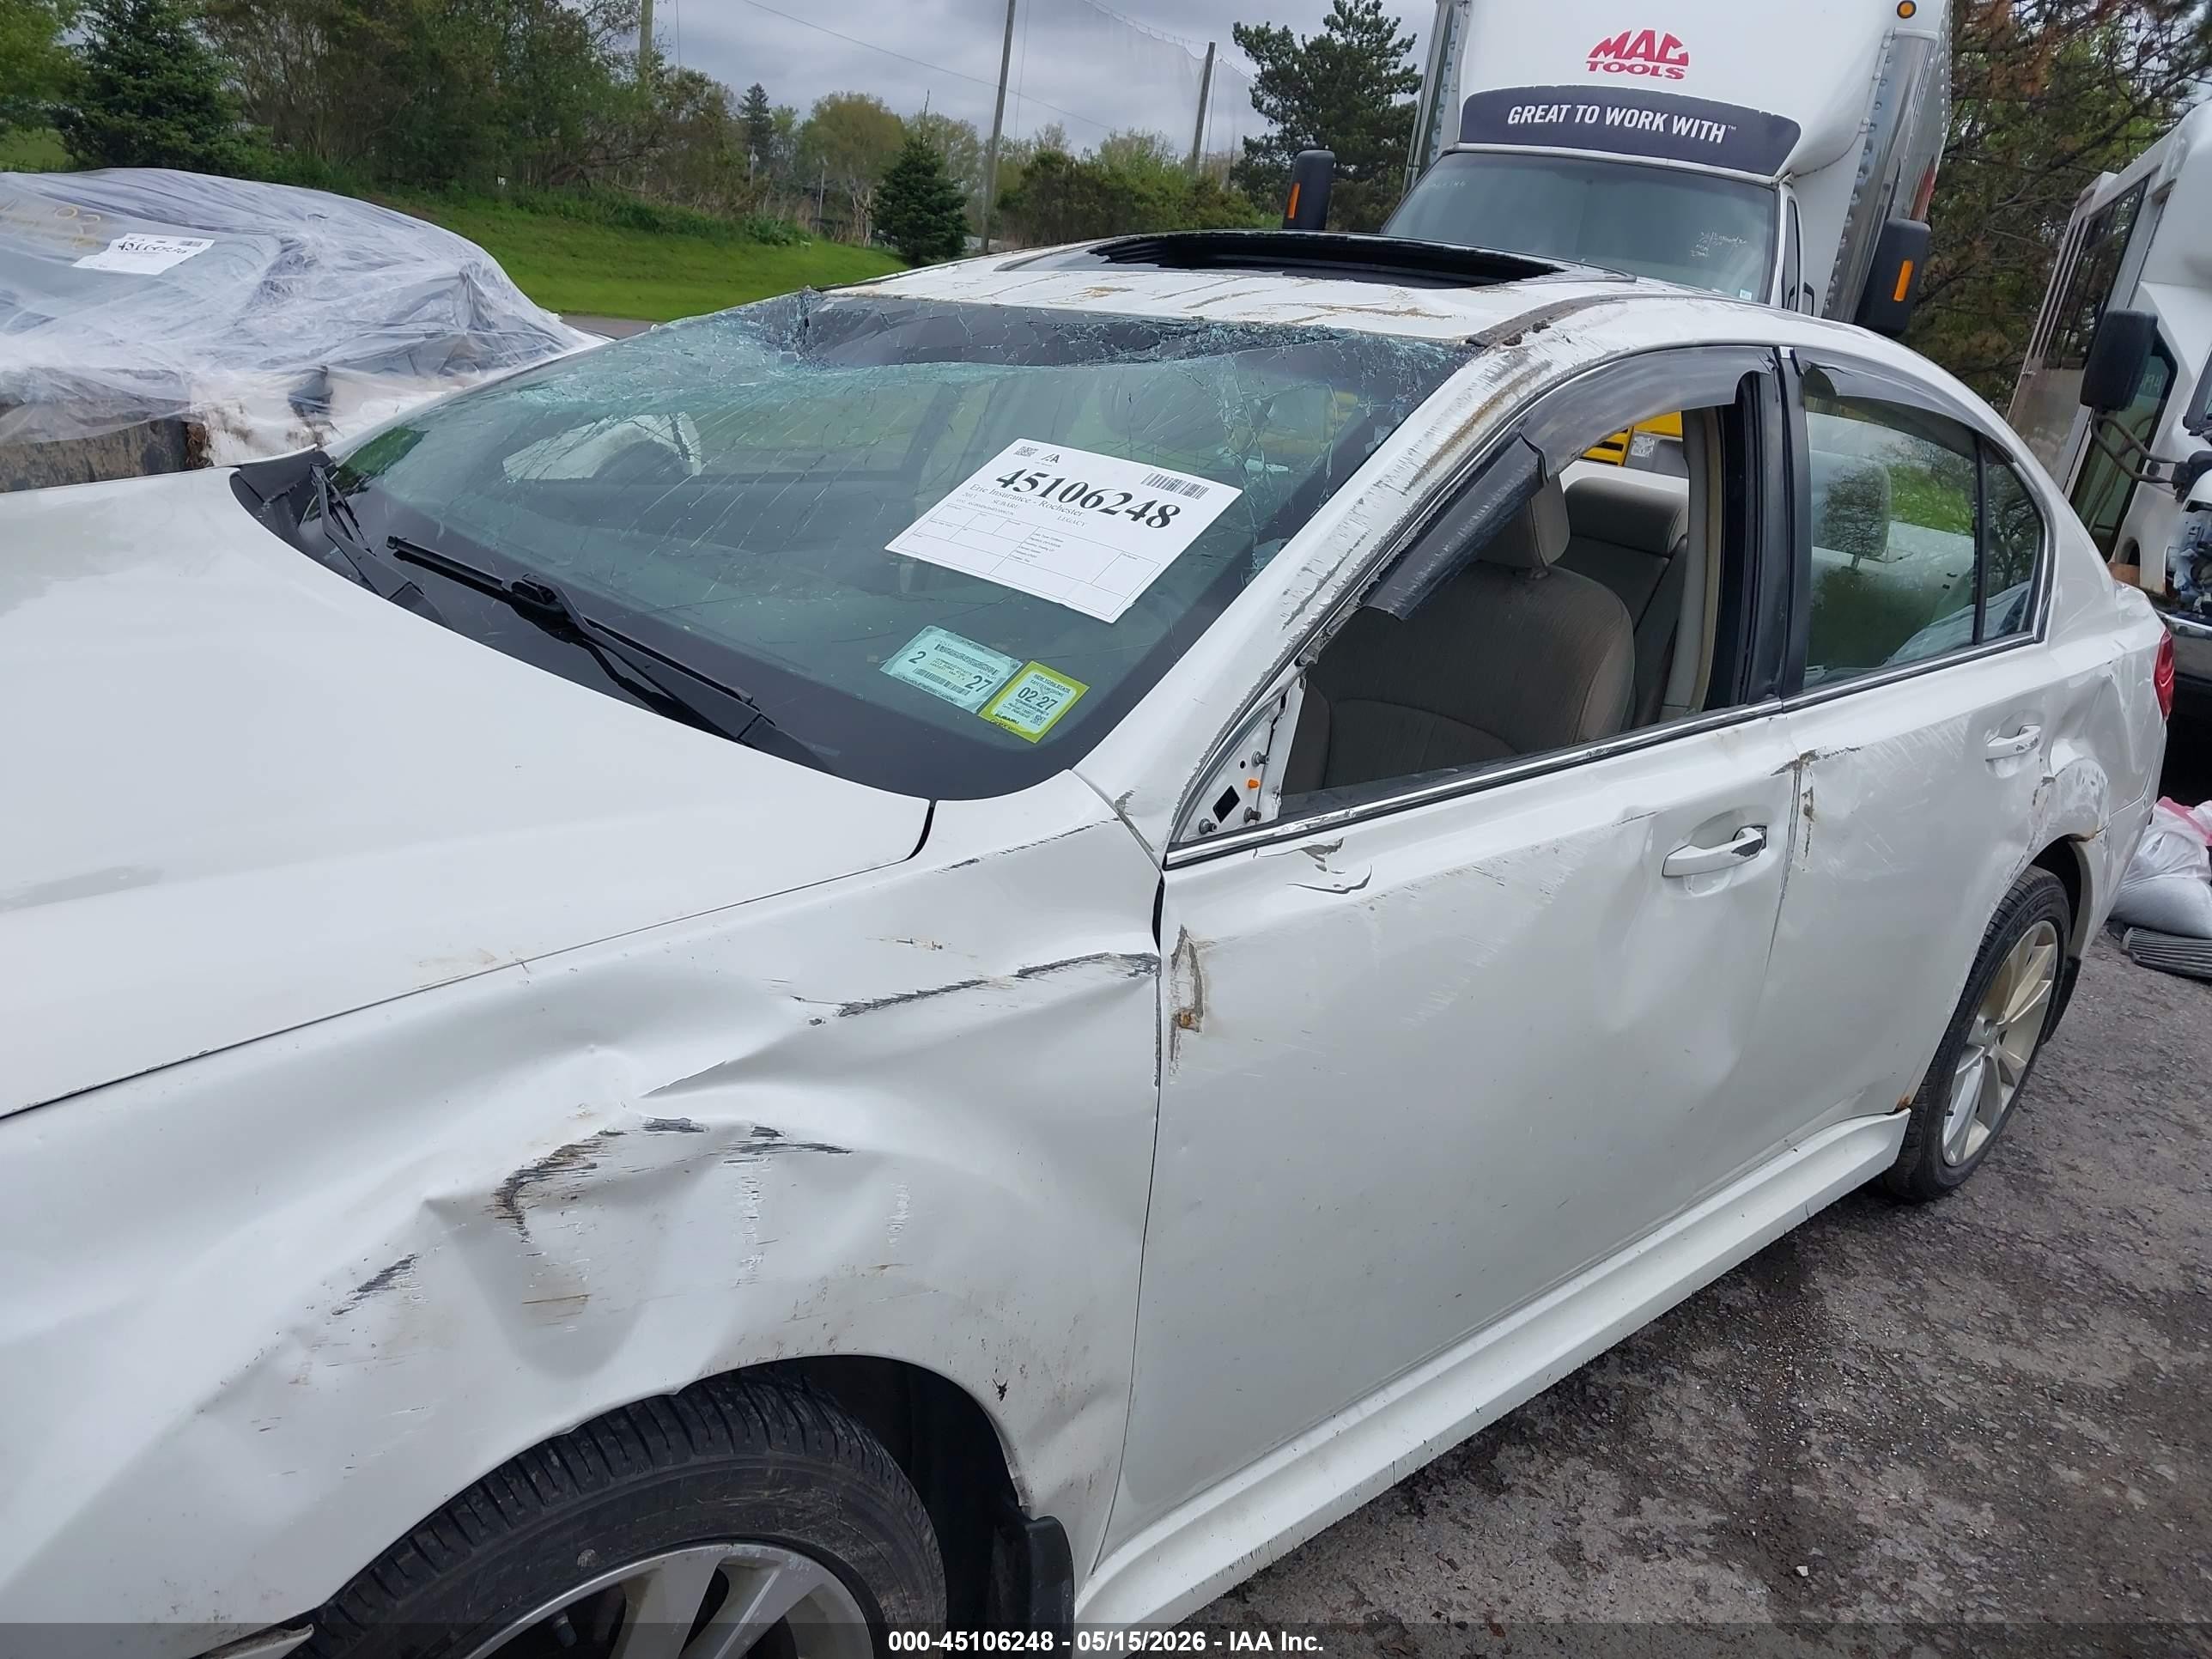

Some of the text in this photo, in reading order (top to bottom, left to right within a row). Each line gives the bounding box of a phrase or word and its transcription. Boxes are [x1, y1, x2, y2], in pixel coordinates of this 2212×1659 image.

[1589, 29, 1689, 66] MAC
[1586, 61, 1685, 80] TOOLS
[1508, 104, 1571, 125] GREAT
[1575, 105, 1600, 124] TO
[1606, 106, 1668, 132] WORK
[970, 483, 989, 495] Erie
[989, 487, 1031, 503] Insurance
[1038, 500, 1085, 517] Rochester
[995, 468, 1181, 529] 45106248
[1057, 515, 1087, 528] LEGACY
[908, 651, 927, 665] 2
[965, 675, 994, 692] 27
